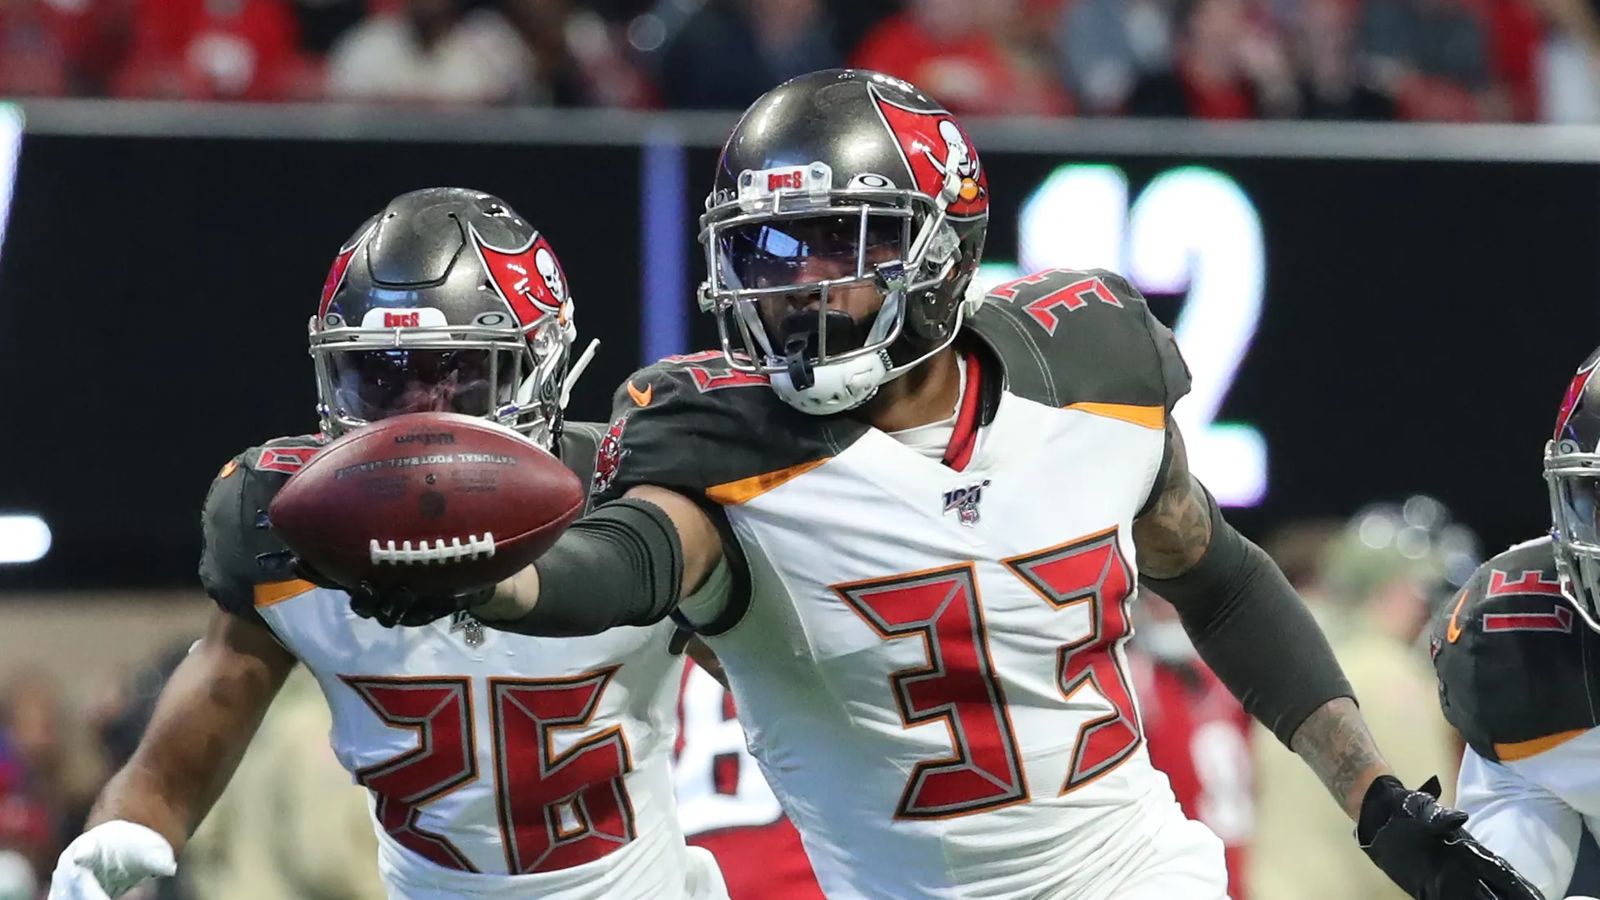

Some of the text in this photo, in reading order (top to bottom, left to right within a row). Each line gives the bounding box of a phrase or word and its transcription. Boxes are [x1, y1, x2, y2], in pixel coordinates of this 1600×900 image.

[334, 453, 517, 480] NATIONAL FOOTBALL LEAGUE
[337, 662, 638, 875] 26
[829, 525, 1146, 822] 33
